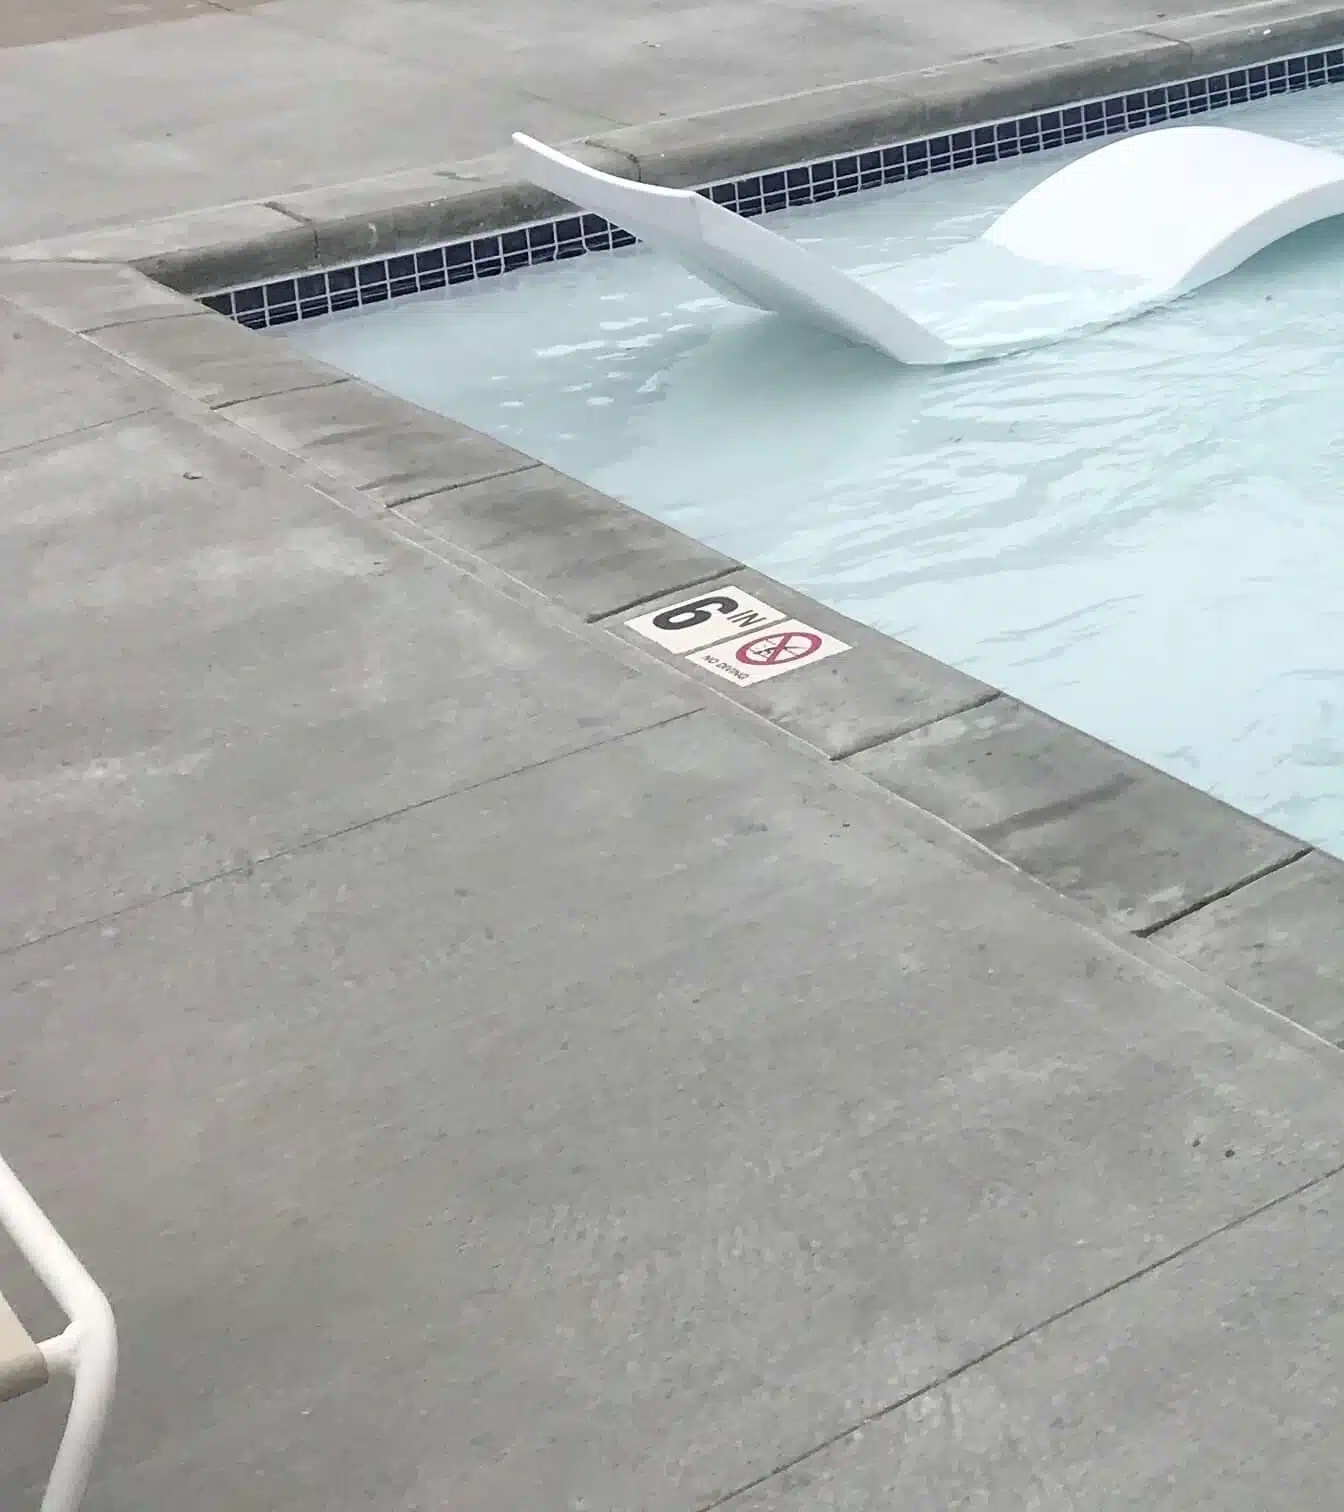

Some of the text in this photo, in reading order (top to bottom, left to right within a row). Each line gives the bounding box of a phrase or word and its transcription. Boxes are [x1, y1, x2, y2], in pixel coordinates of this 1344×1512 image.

[652, 596, 767, 630] 6 IN
[702, 654, 750, 680] NO DIVING
